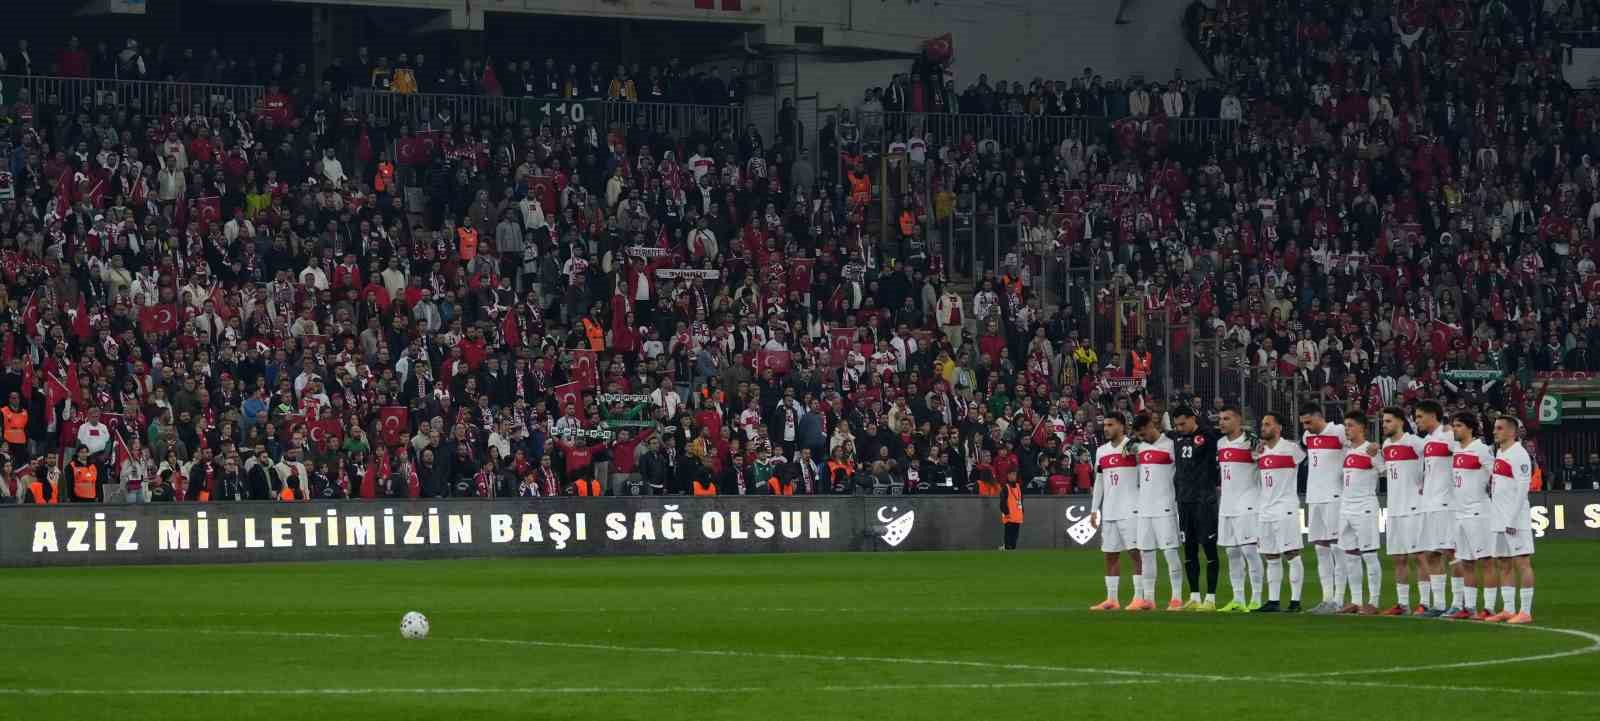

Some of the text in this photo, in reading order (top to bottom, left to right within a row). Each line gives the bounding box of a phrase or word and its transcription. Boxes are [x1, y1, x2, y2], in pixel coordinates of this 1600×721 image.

[540, 102, 584, 122] 110
[1539, 394, 1558, 421] B
[1181, 446, 1193, 458] 23
[1110, 473, 1119, 486] 19
[1145, 470, 1150, 482] 2
[1223, 468, 1231, 481] 14
[1264, 475, 1273, 488] 10
[1530, 504, 1600, 537] ŞI S
[32, 505, 831, 552] AZİZ MİLLETİMİZİN BAŞI SAĞ OLSUN
